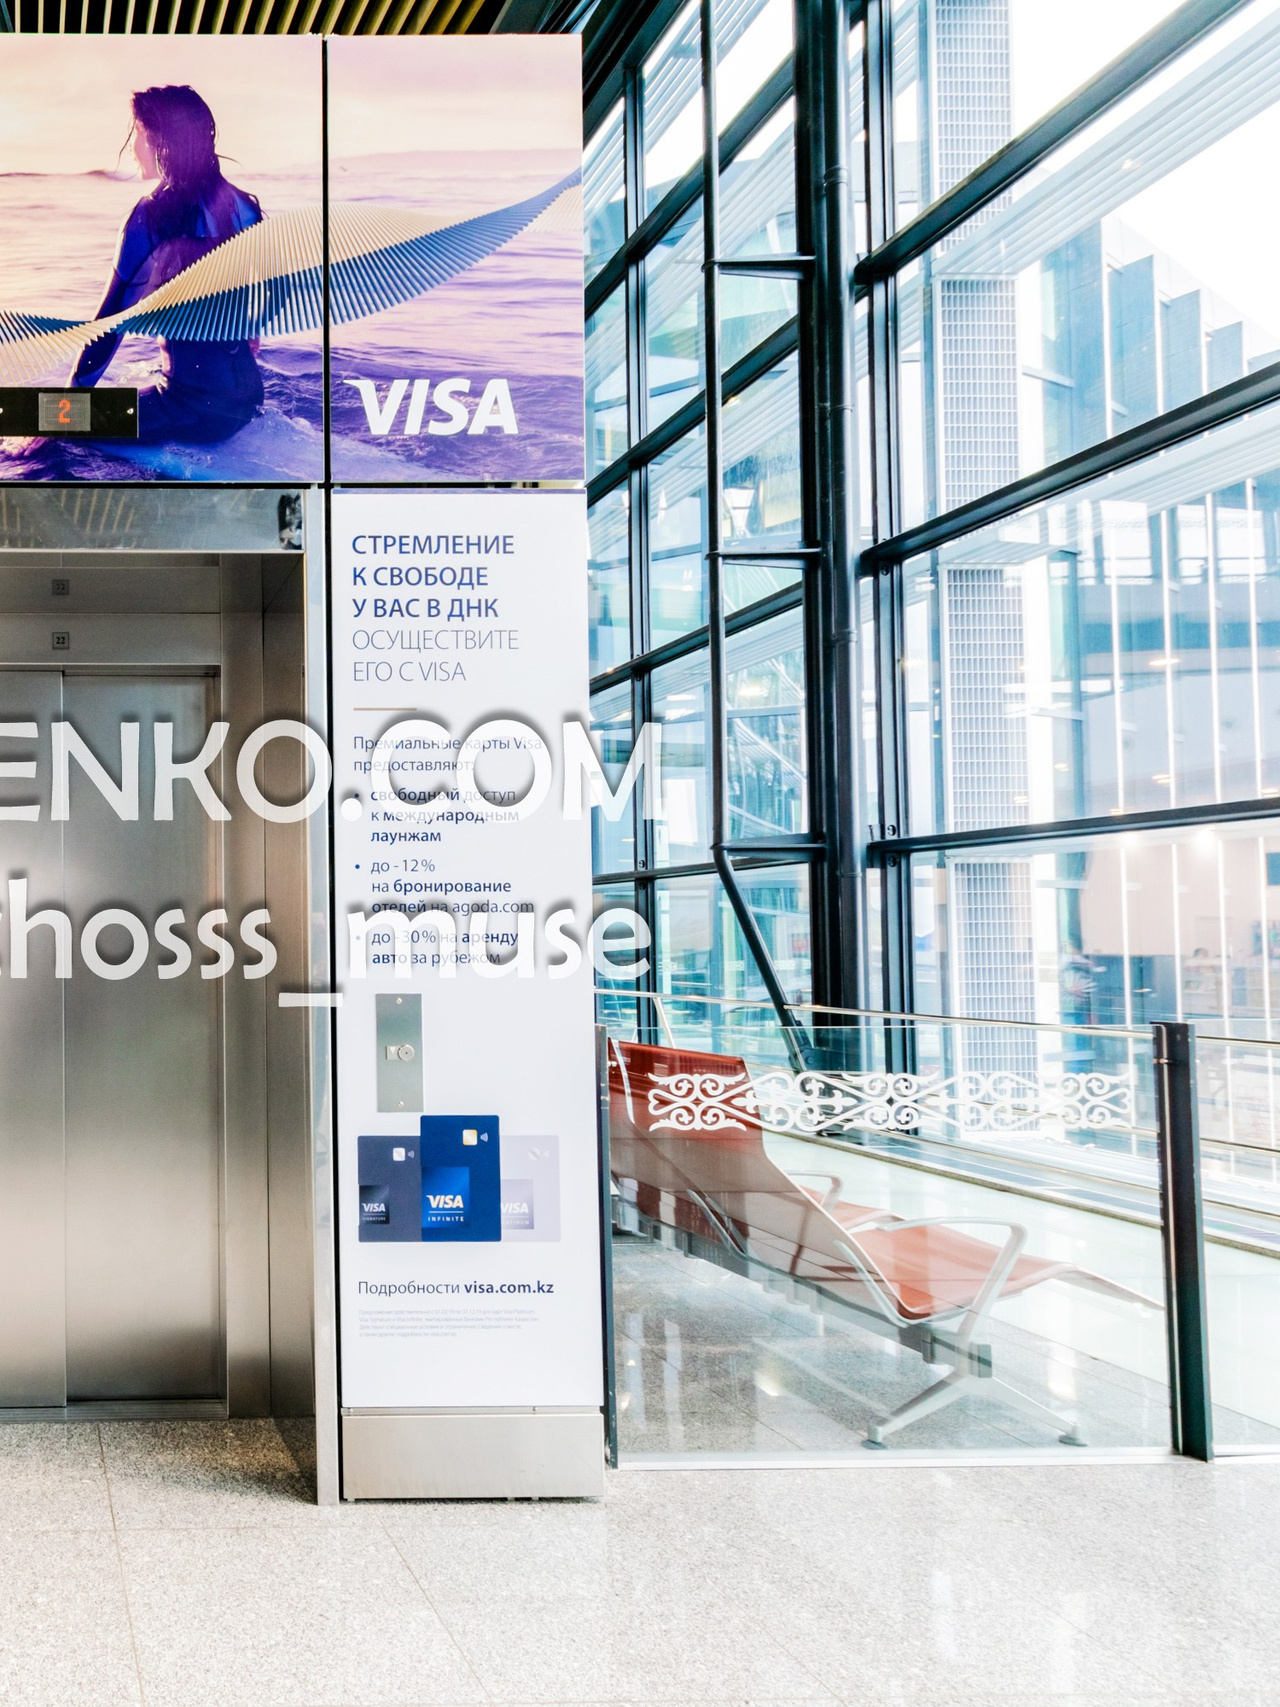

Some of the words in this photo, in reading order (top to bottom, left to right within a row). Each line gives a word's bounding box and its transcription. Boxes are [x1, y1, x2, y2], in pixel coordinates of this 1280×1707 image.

[58, 399, 71, 424] 2
[343, 378, 519, 436] VISA
[352, 535, 515, 555] СТРЕМЛЕНИЕ
[353, 567, 367, 586] К
[373, 566, 489, 590] СВОБОДЕ
[352, 598, 368, 618] У
[373, 598, 420, 618] ВАС
[427, 598, 441, 618] В
[447, 598, 499, 622] ДНК
[352, 629, 520, 654] ОСУЩЕСТВИТЕ
[354, 661, 393, 681] ЕГО
[399, 661, 414, 681] С
[417, 661, 467, 681] VISA
[353, 736, 461, 752] Премиальные
[464, 738, 511, 753] карты
[513, 736, 543, 750] Visa
[371, 788, 460, 804] свободный
[464, 789, 517, 804] доступ
[371, 811, 380, 822] к
[371, 831, 442, 844] лаунжам
[371, 862, 390, 875] до
[372, 882, 389, 893] на
[393, 879, 512, 896] бронирование
[372, 900, 426, 914] отелей
[431, 903, 448, 914] на
[452, 900, 535, 916] agoda.com
[371, 933, 391, 946] до
[439, 933, 457, 944] на
[461, 933, 519, 948] аренду
[372, 954, 407, 964] авто
[412, 954, 427, 964] за
[431, 950, 501, 967] рубежом
[362, 1203, 386, 1212] VISA
[426, 1195, 464, 1208] VISA
[358, 1281, 460, 1297] Подробности
[464, 1280, 554, 1294] visa.com.kz
